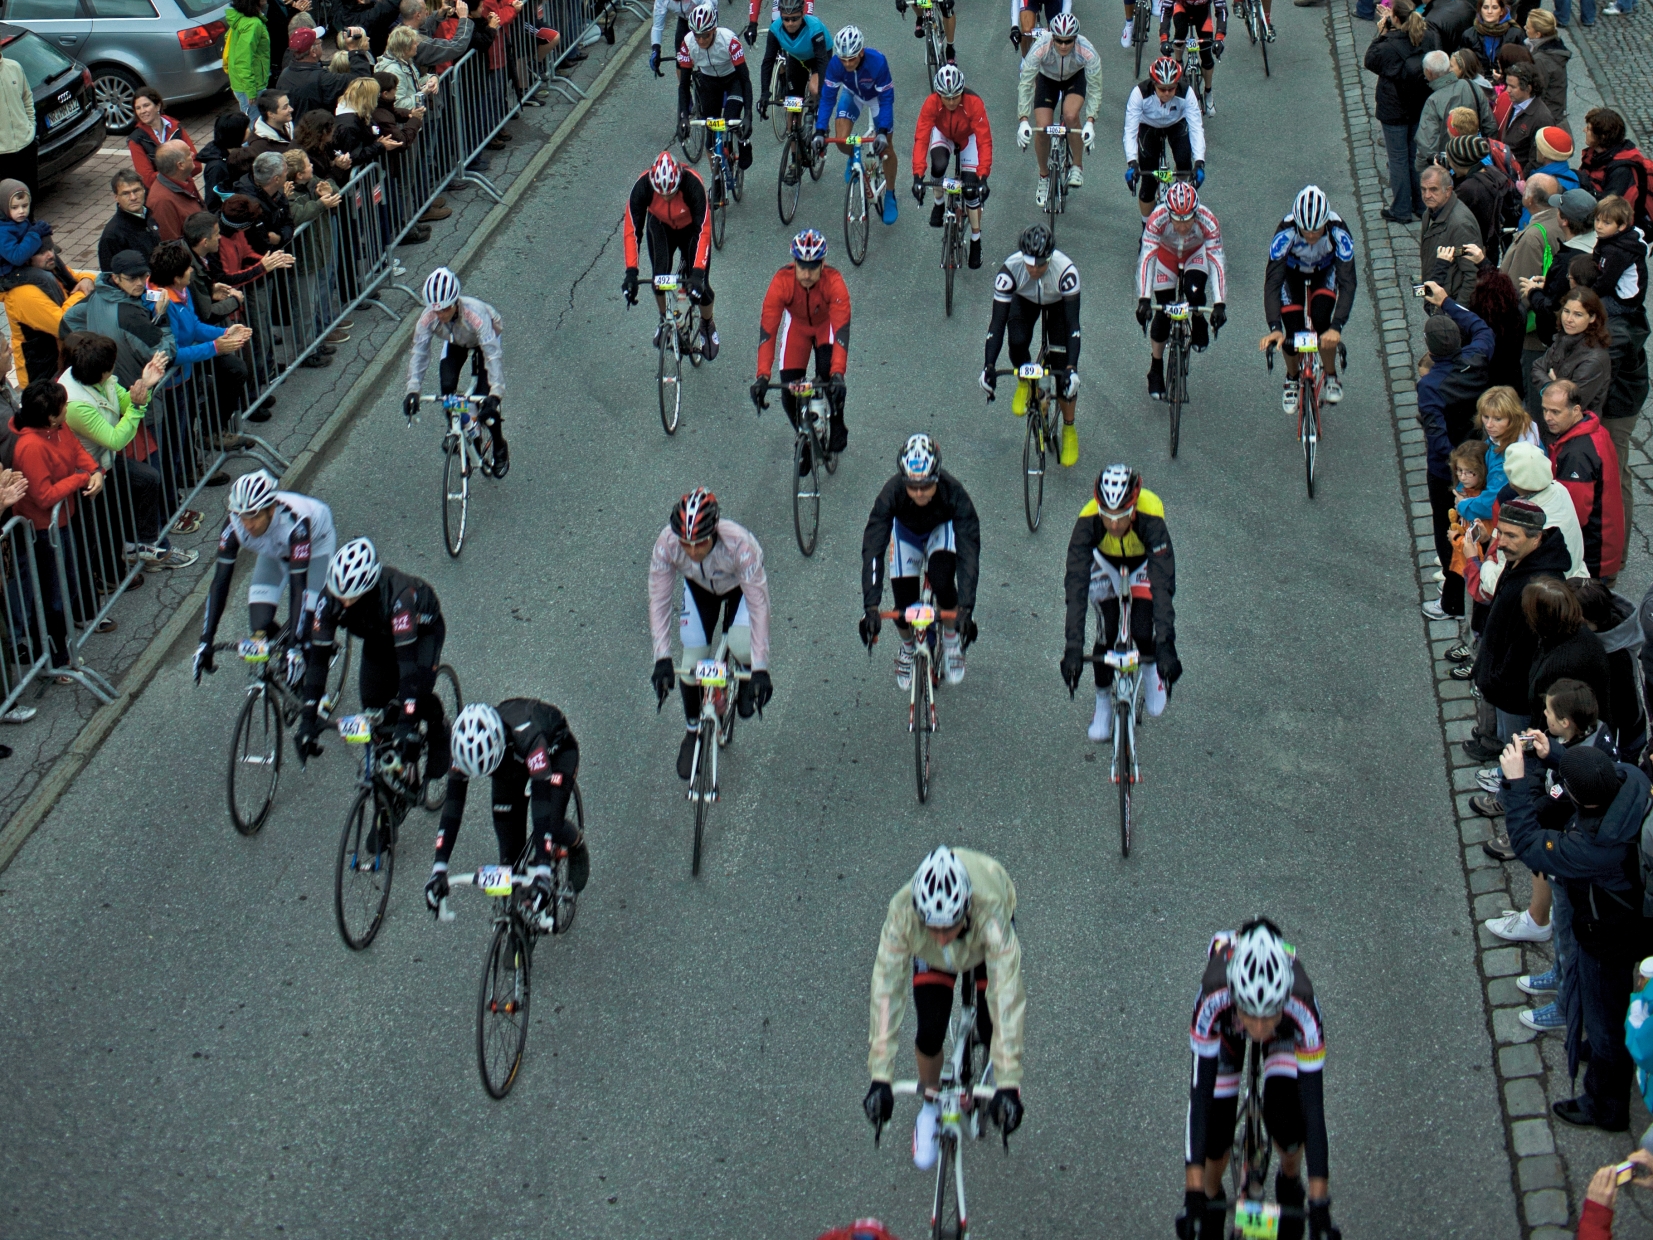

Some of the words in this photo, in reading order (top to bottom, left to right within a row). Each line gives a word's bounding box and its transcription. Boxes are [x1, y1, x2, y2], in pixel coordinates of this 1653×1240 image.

[657, 275, 670, 285] 492
[996, 274, 1008, 289] 11
[1061, 275, 1075, 291] 11
[1169, 305, 1183, 315] 407
[1301, 337, 1306, 346] 3
[1024, 367, 1035, 376] 89
[915, 608, 921, 618] 7
[699, 667, 719, 678] 429
